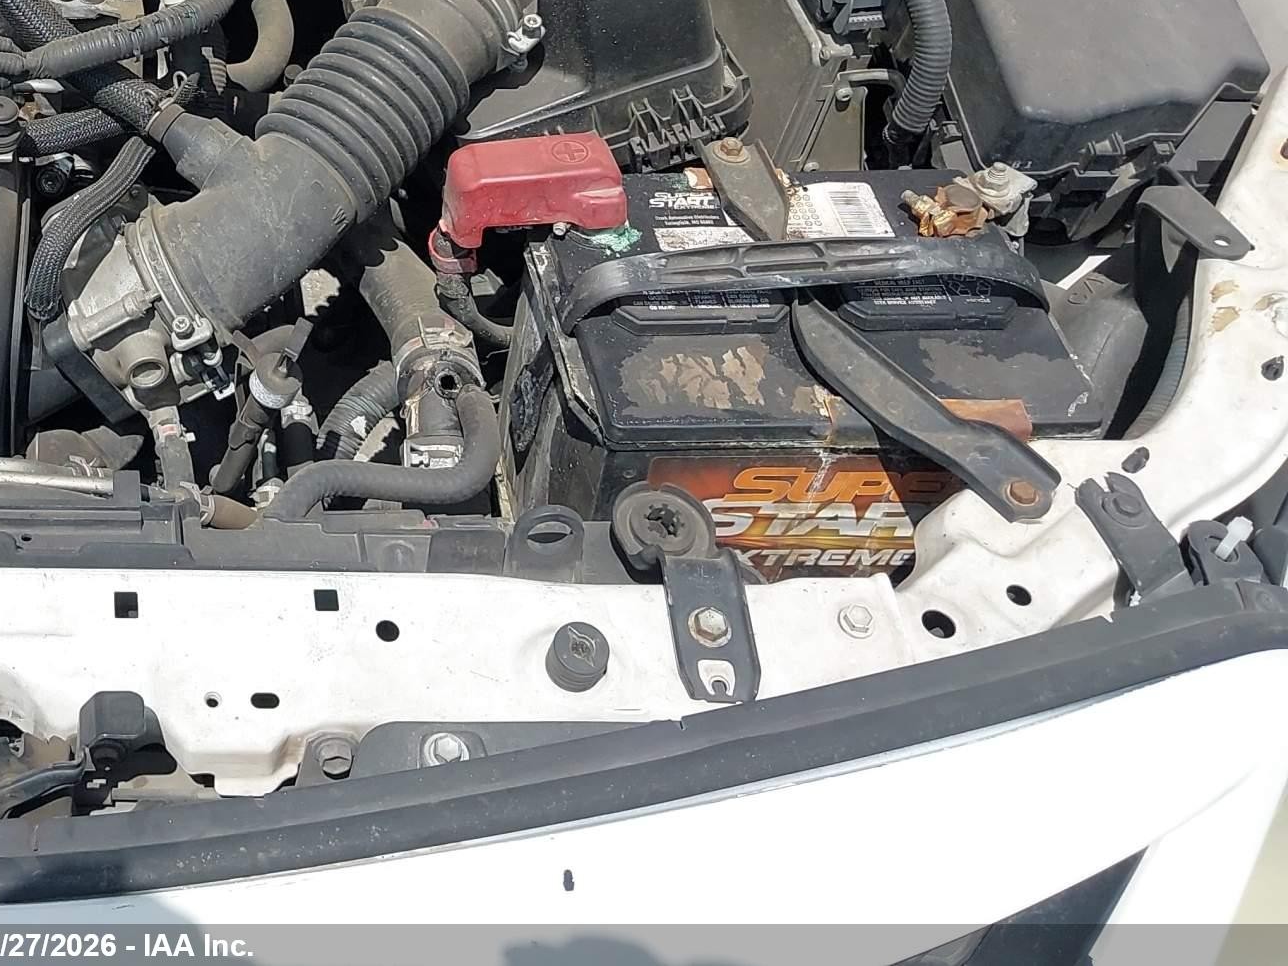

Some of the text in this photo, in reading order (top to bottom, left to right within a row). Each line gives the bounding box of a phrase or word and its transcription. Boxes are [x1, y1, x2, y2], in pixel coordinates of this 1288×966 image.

[649, 197, 715, 208] START
[654, 192, 712, 200] SUPER
[723, 466, 965, 502] SUPE
[702, 499, 916, 536] STAR
[738, 548, 915, 567] XTREME
